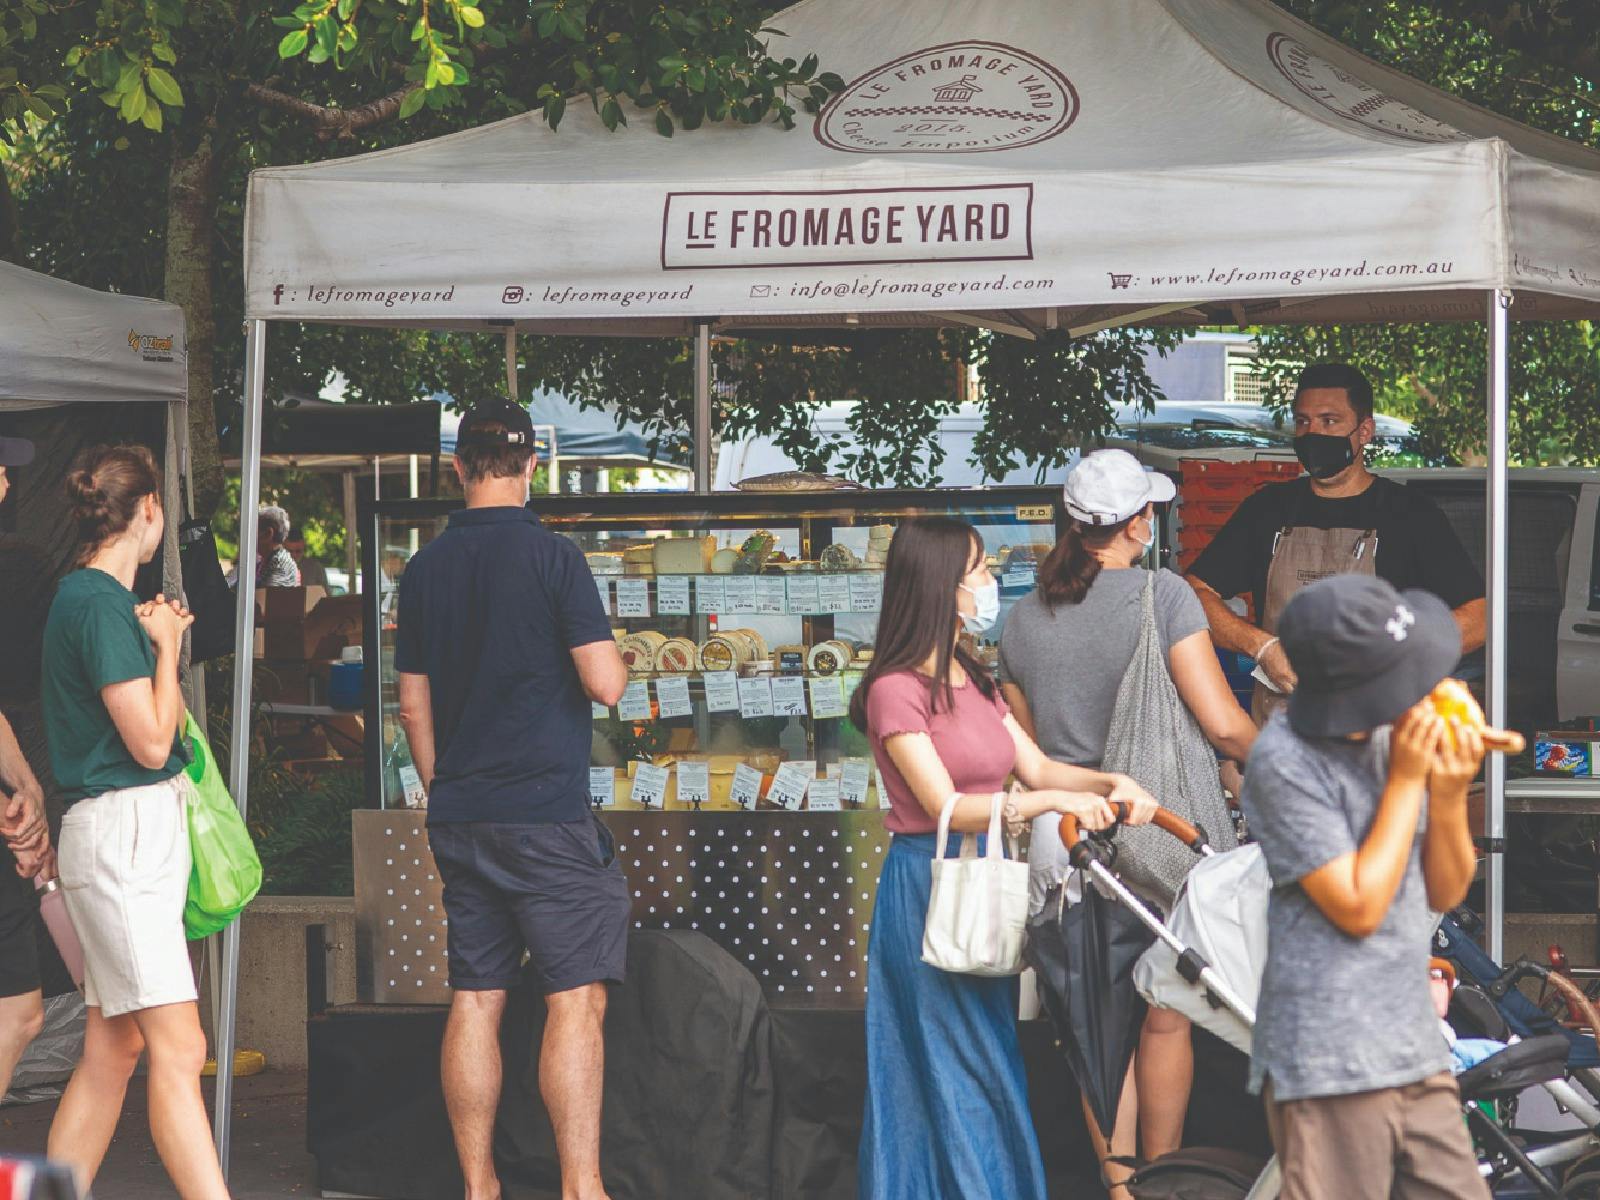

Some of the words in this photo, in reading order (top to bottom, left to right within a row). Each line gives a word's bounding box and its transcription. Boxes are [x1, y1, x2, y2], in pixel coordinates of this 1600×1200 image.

[858, 83, 891, 100] LE
[895, 54, 1019, 82] FROMAGE
[1018, 74, 1054, 110] YARD
[843, 121, 889, 148] Cheese
[900, 125, 1035, 149] Emporium
[687, 211, 718, 240] LE
[730, 207, 905, 249] FROMAGE
[916, 203, 1010, 243] YARD
[1150, 260, 1452, 286] www.lefromageyard.com.au
[307, 285, 455, 308] lefromageyard
[543, 284, 693, 307] lefromageyard
[790, 274, 1054, 299] info@lefromageyard.com
